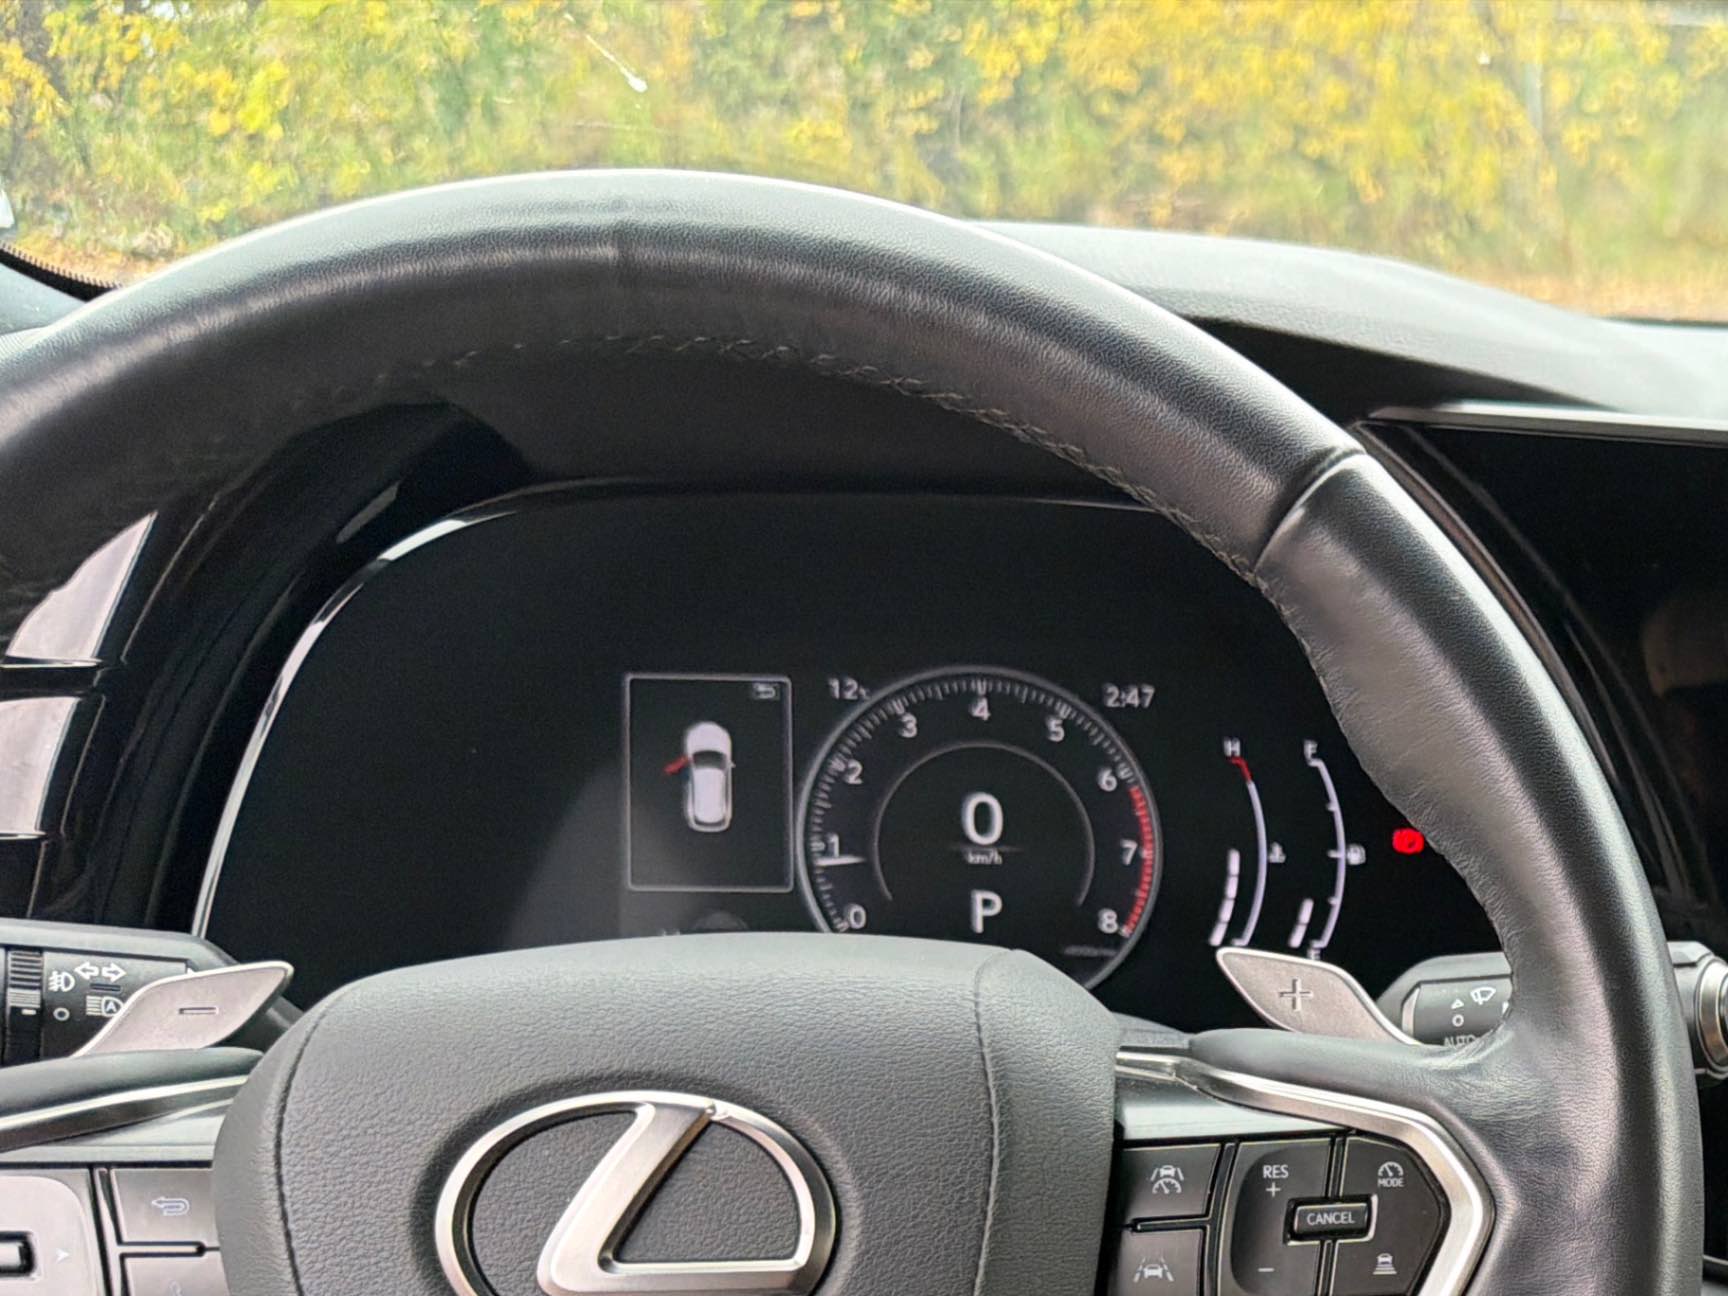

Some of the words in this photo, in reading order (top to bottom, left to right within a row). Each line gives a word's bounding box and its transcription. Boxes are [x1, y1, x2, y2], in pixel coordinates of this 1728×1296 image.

[1104, 684, 1155, 708] 2:47
[971, 698, 990, 720] 4
[900, 712, 918, 738] 3
[1047, 718, 1065, 742] 5
[846, 760, 863, 785] 2
[1098, 766, 1117, 792] 6
[962, 791, 1004, 846] 0
[827, 833, 840, 857] 1
[967, 849, 1003, 865] km/h
[1120, 839, 1138, 865] 7
[845, 903, 867, 929] 0
[970, 889, 1003, 934] P
[1098, 907, 1118, 934] 8
[1262, 1164, 1289, 1179] RES
[1377, 1177, 1404, 1188] MODE
[1306, 1210, 1355, 1226] CANCEL
